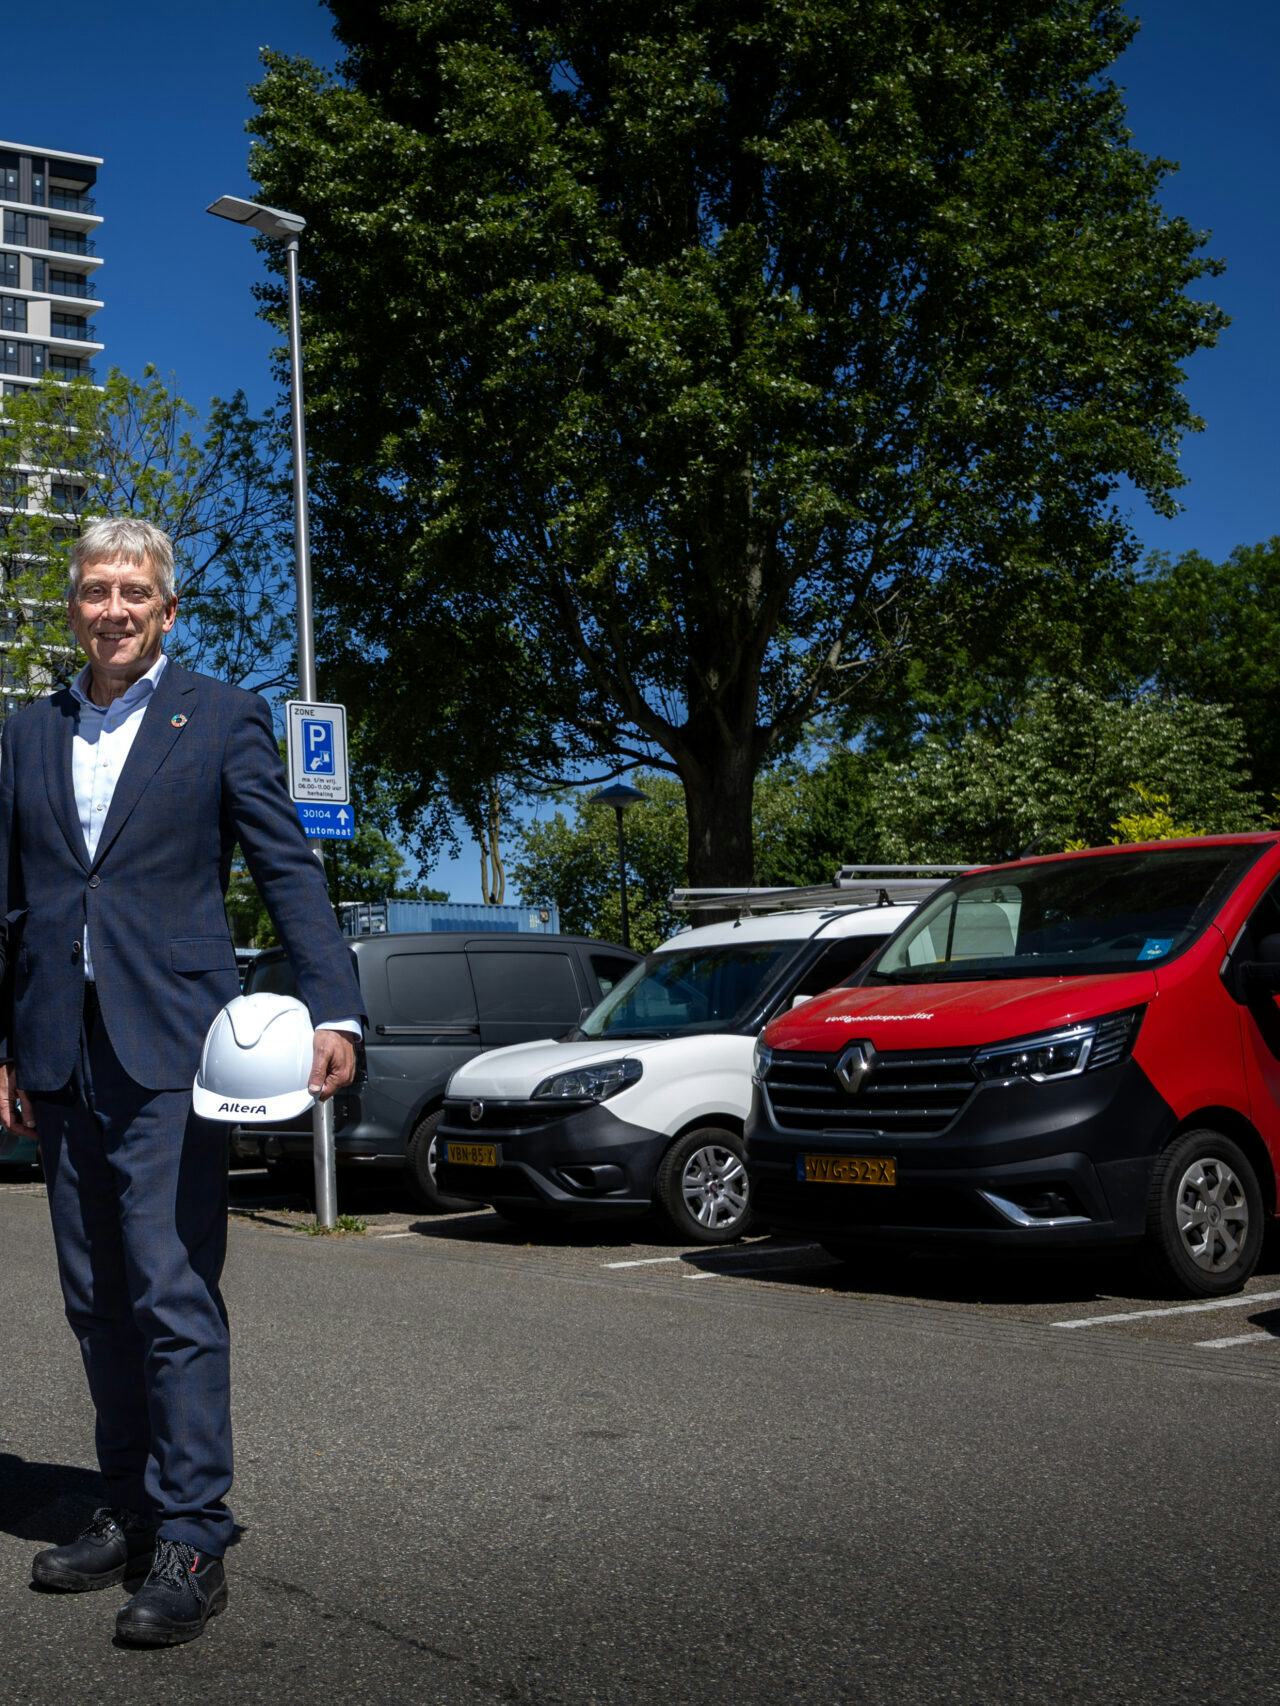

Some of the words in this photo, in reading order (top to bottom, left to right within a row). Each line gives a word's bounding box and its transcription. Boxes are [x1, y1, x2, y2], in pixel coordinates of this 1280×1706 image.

[294, 708, 315, 717] ZONE
[309, 724, 326, 752] P
[303, 809, 331, 819] 30104
[218, 1102, 267, 1115] AlterA
[808, 1159, 890, 1181] VVG-52-X
